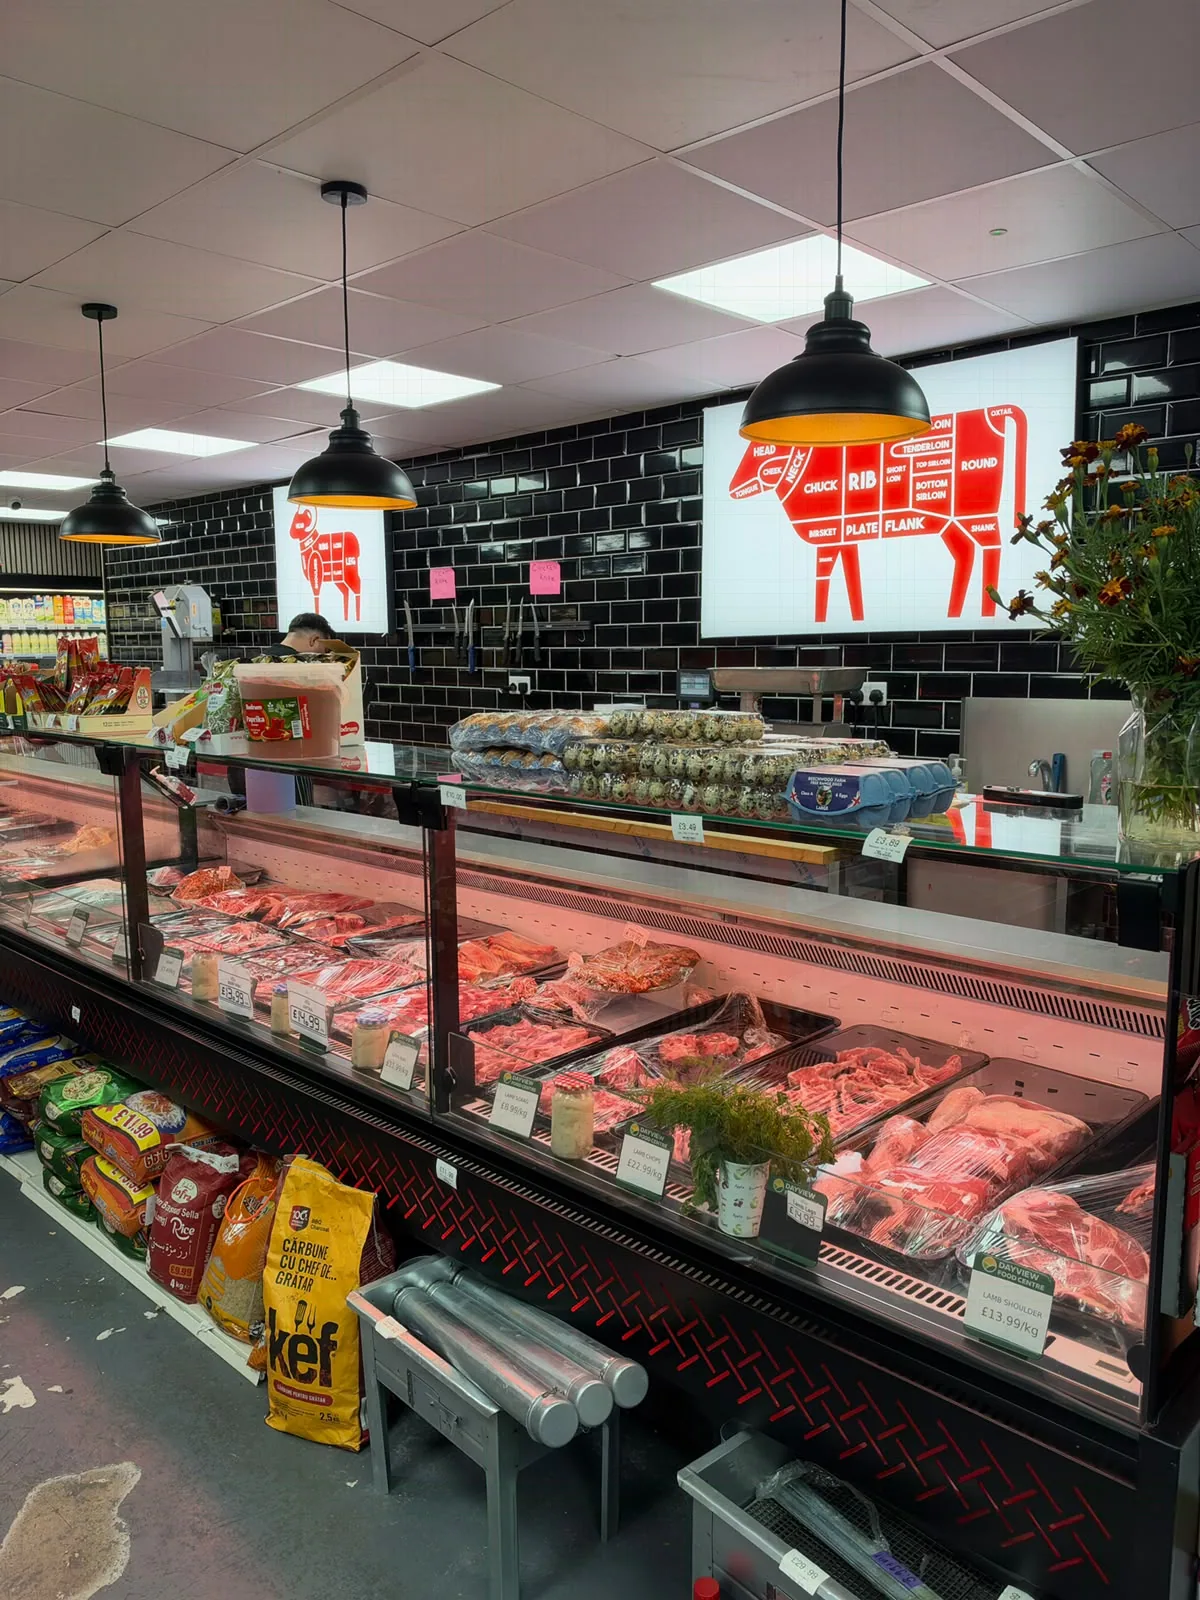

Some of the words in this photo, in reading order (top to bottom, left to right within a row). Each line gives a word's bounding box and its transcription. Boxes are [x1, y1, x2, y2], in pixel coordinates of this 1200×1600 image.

[991, 408, 1013, 416] OXTAIL
[753, 445, 776, 457] HEAD
[903, 440, 950, 454] TENDERLOIN
[762, 467, 782, 476] CHEEK
[785, 449, 806, 484] NECK
[886, 465, 907, 474] SHORT
[916, 461, 927, 469] TOP
[928, 459, 951, 467] SIRLOIN
[961, 457, 998, 471] ROUND
[804, 479, 839, 494] CHUCK
[849, 470, 877, 491] RIB
[886, 475, 901, 483] LOIN
[916, 479, 948, 490] BOTTOM
[735, 483, 759, 498] TONGUE
[916, 491, 947, 501] SIRLOIN
[846, 522, 878, 536] PLATE
[885, 516, 926, 532] FLANK
[971, 522, 997, 532] SHANK
[221, 986, 245, 1005] £13.99
[293, 1009, 320, 1031] £14.99
[640, 1127, 665, 1141] DAYVIEW
[627, 1158, 663, 1182] £22.99/kg
[785, 1183, 817, 1200] DAYVIEW
[181, 1207, 200, 1219] Sella
[170, 1217, 196, 1240] Rice
[282, 1237, 329, 1260] CĂRBUNE
[280, 1255, 297, 1270] CU
[298, 1258, 321, 1276] CHEF
[998, 1261, 1040, 1281] DAYVIEW
[275, 1271, 314, 1293] GRĂTAR
[997, 1270, 1018, 1282] FOOD
[1017, 1277, 1045, 1292] CENTRE
[983, 1291, 1002, 1304] LAMB
[1003, 1298, 1043, 1319] SHOULDER
[981, 1306, 1039, 1338] £13.99/kg
[268, 1306, 340, 1388] kef
